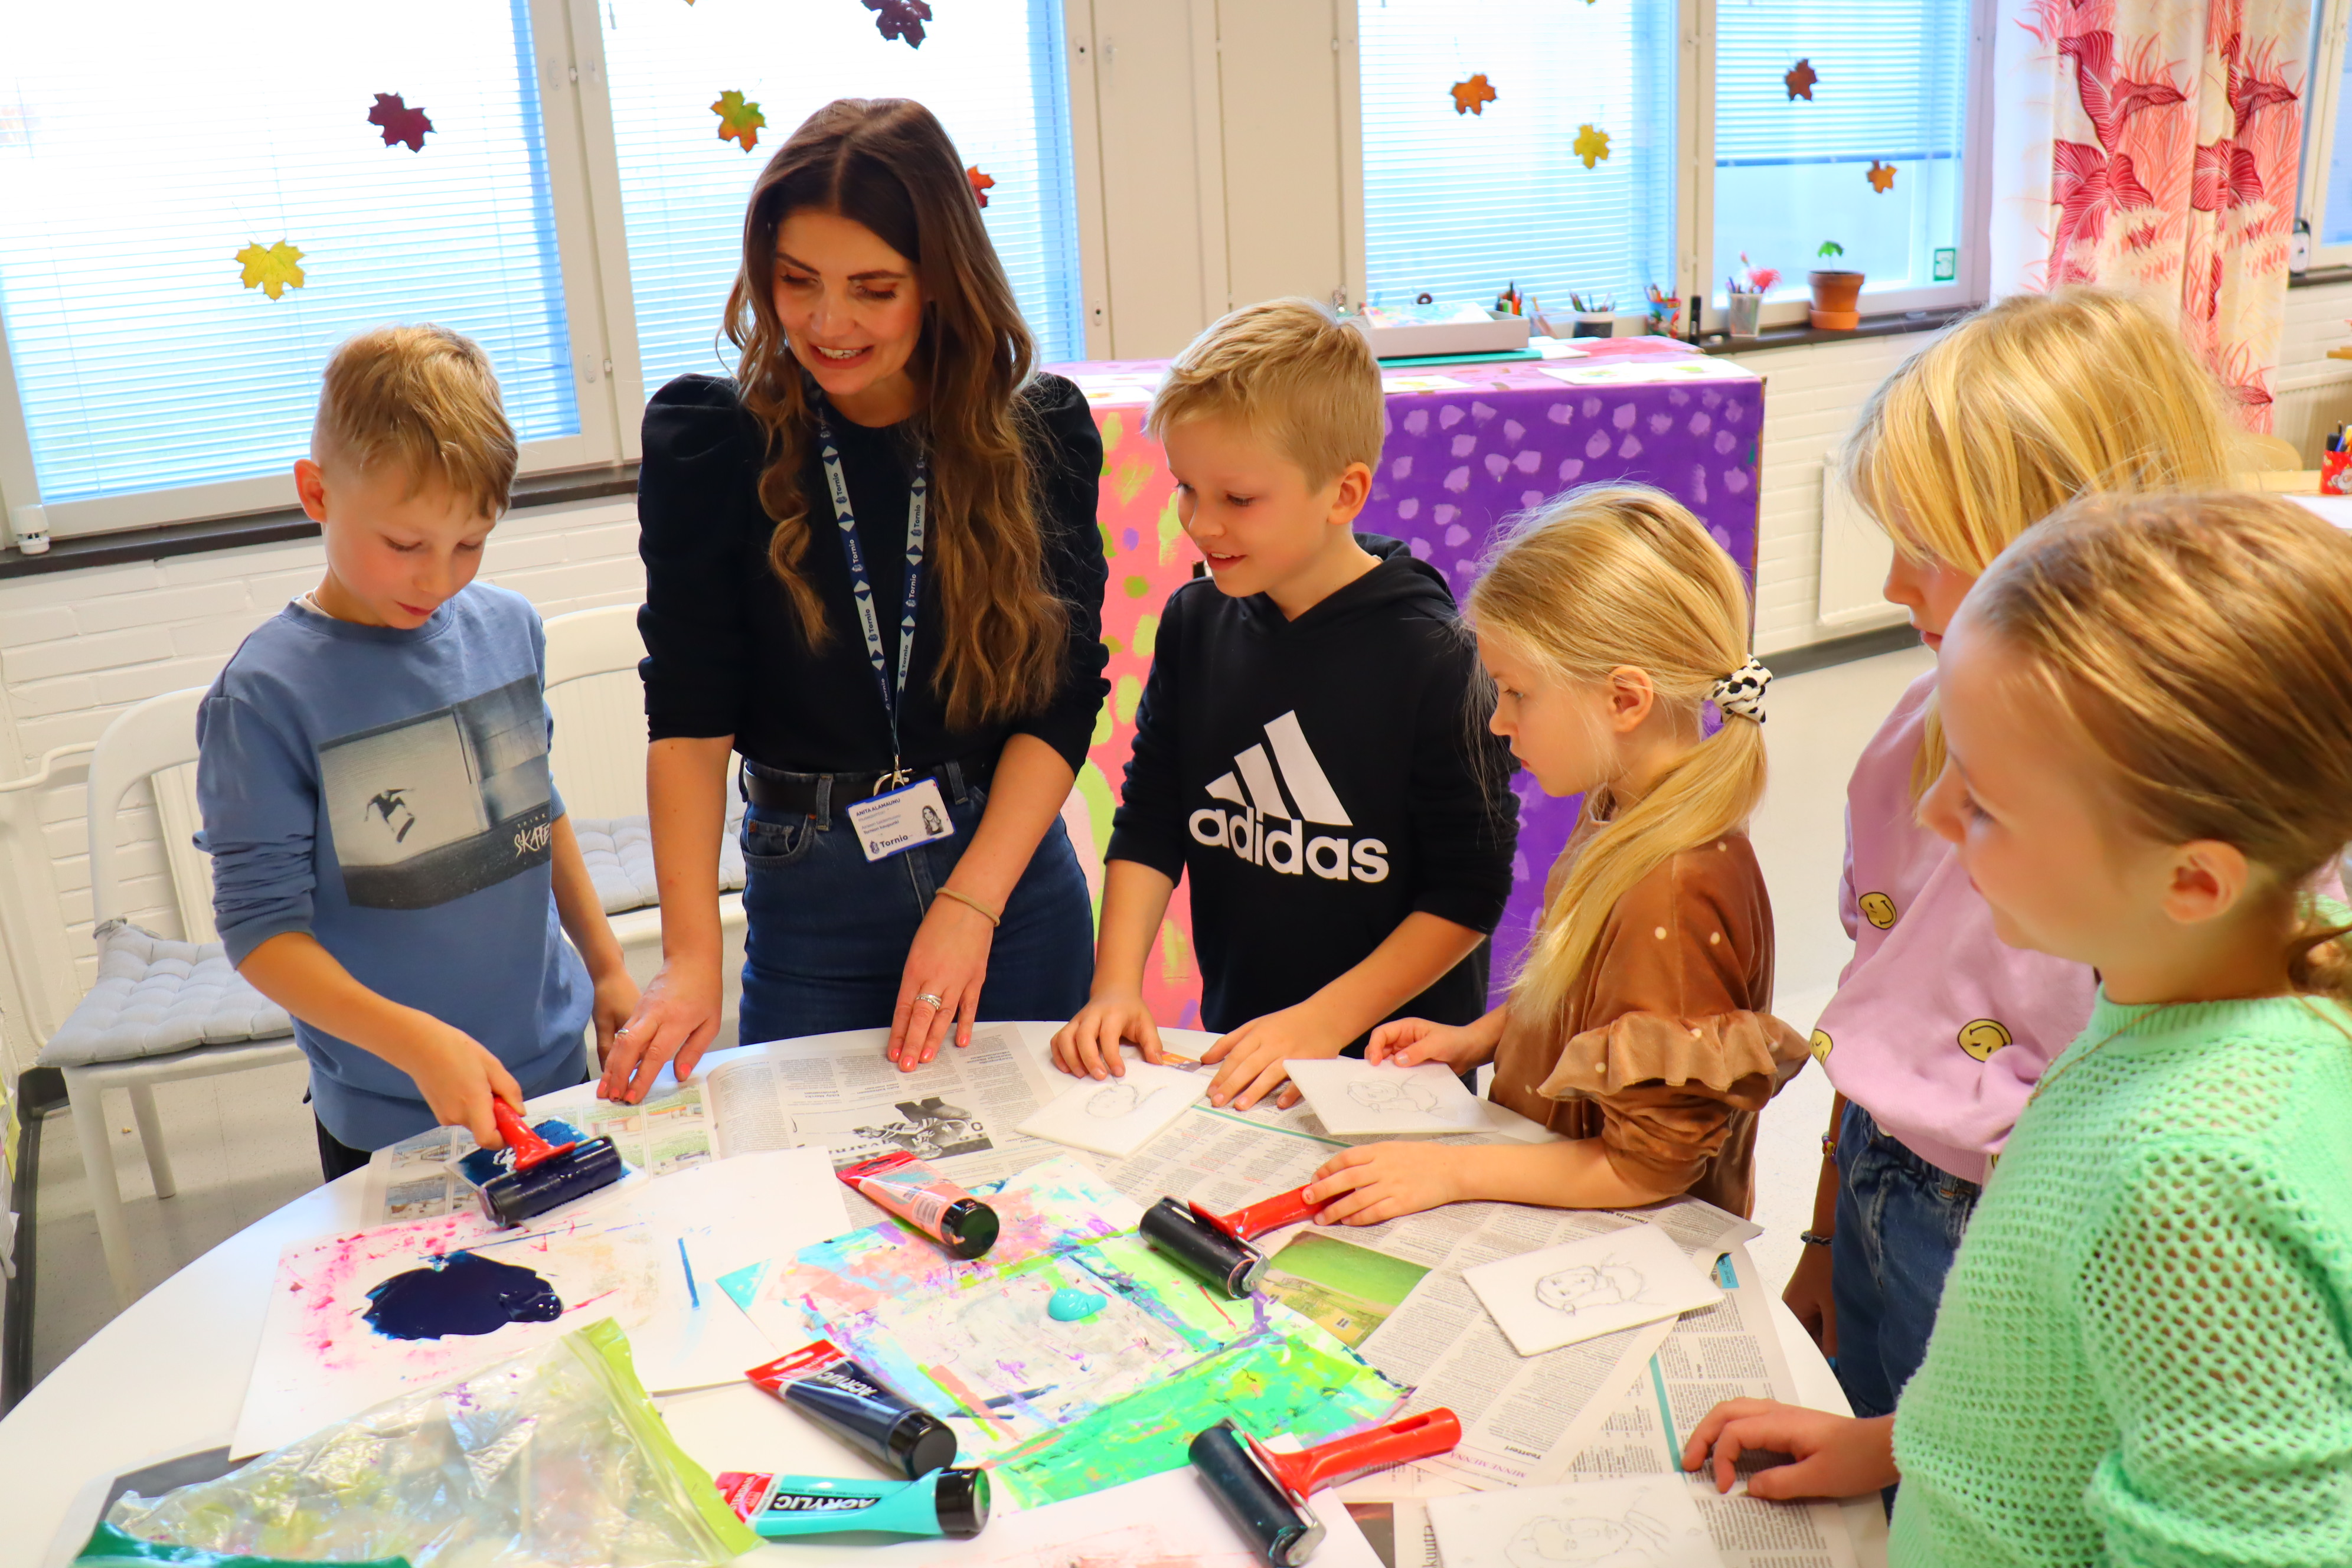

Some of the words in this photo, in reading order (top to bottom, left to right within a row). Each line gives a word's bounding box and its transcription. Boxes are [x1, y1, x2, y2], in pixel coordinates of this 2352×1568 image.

[833, 472, 843, 496] Tornio
[849, 539, 859, 563] Tornio
[909, 573, 917, 598] Tornio
[865, 608, 874, 633] Tornio
[856, 808, 871, 816] ANITA
[871, 798, 900, 811] ALAMAUNU
[514, 822, 550, 859] SKATE
[880, 835, 909, 848] Tornio
[1189, 806, 1389, 883] adidas
[816, 1371, 878, 1396] ACRYLIC
[1504, 1445, 1541, 1459] Teatteri
[1491, 1463, 1527, 1478] MINNE
[730, 1475, 756, 1511] STERDAM
[773, 1495, 876, 1511] ACRYLIC
